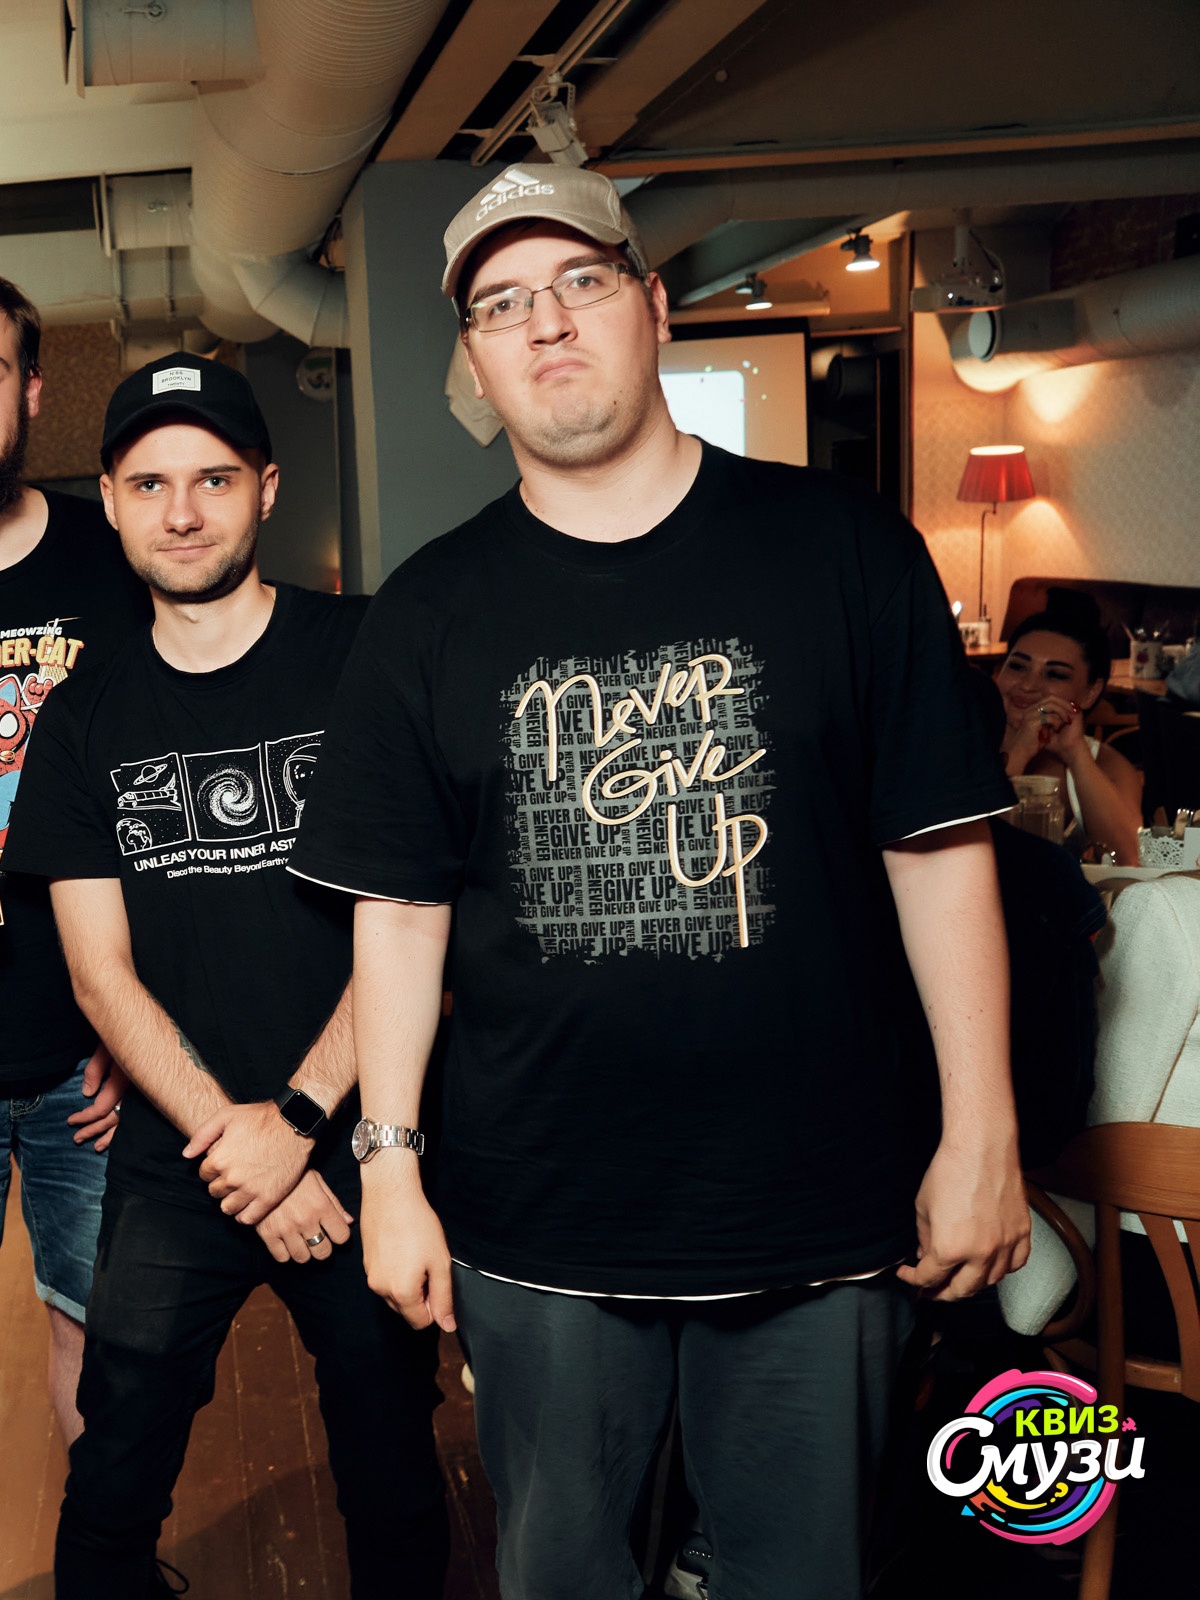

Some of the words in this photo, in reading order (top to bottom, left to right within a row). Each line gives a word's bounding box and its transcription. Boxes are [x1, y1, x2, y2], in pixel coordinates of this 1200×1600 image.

[475, 183, 555, 222] adidas
[161, 376, 191, 384] BROOKLYN
[526, 712, 541, 747] NEVER
[646, 725, 677, 739] NEVER
[529, 792, 552, 805] GIVE
[554, 791, 567, 803] UP
[532, 808, 570, 825] NEVER
[534, 825, 550, 861] NEVER
[550, 823, 591, 848] GIVE
[636, 819, 652, 855] NEVER
[186, 848, 227, 860] YOUR
[230, 843, 266, 860] INNER
[551, 847, 582, 861] NEVER
[584, 845, 607, 859] GIVE
[609, 845, 622, 857] UP
[688, 838, 711, 852] GIVE
[188, 866, 203, 875] the
[204, 865, 233, 875] Beauty
[530, 867, 554, 882] GIVE
[558, 865, 573, 881] UP
[587, 863, 624, 879] NEVER
[629, 861, 656, 877] GIVE
[551, 881, 574, 904] UP
[603, 877, 645, 902] GIVE
[651, 876, 676, 899] UP
[588, 880, 603, 916] NEVER
[541, 905, 560, 918] GIVE
[563, 904, 575, 917] UP
[604, 902, 635, 915] NEVER
[638, 900, 661, 913] GIVE
[664, 899, 678, 911] UP
[542, 923, 577, 937] NEVER
[581, 921, 606, 937] GIVE
[609, 921, 626, 936] UP
[641, 918, 680, 933] NEVER
[685, 916, 711, 932] GIVE
[716, 915, 732, 929] UP
